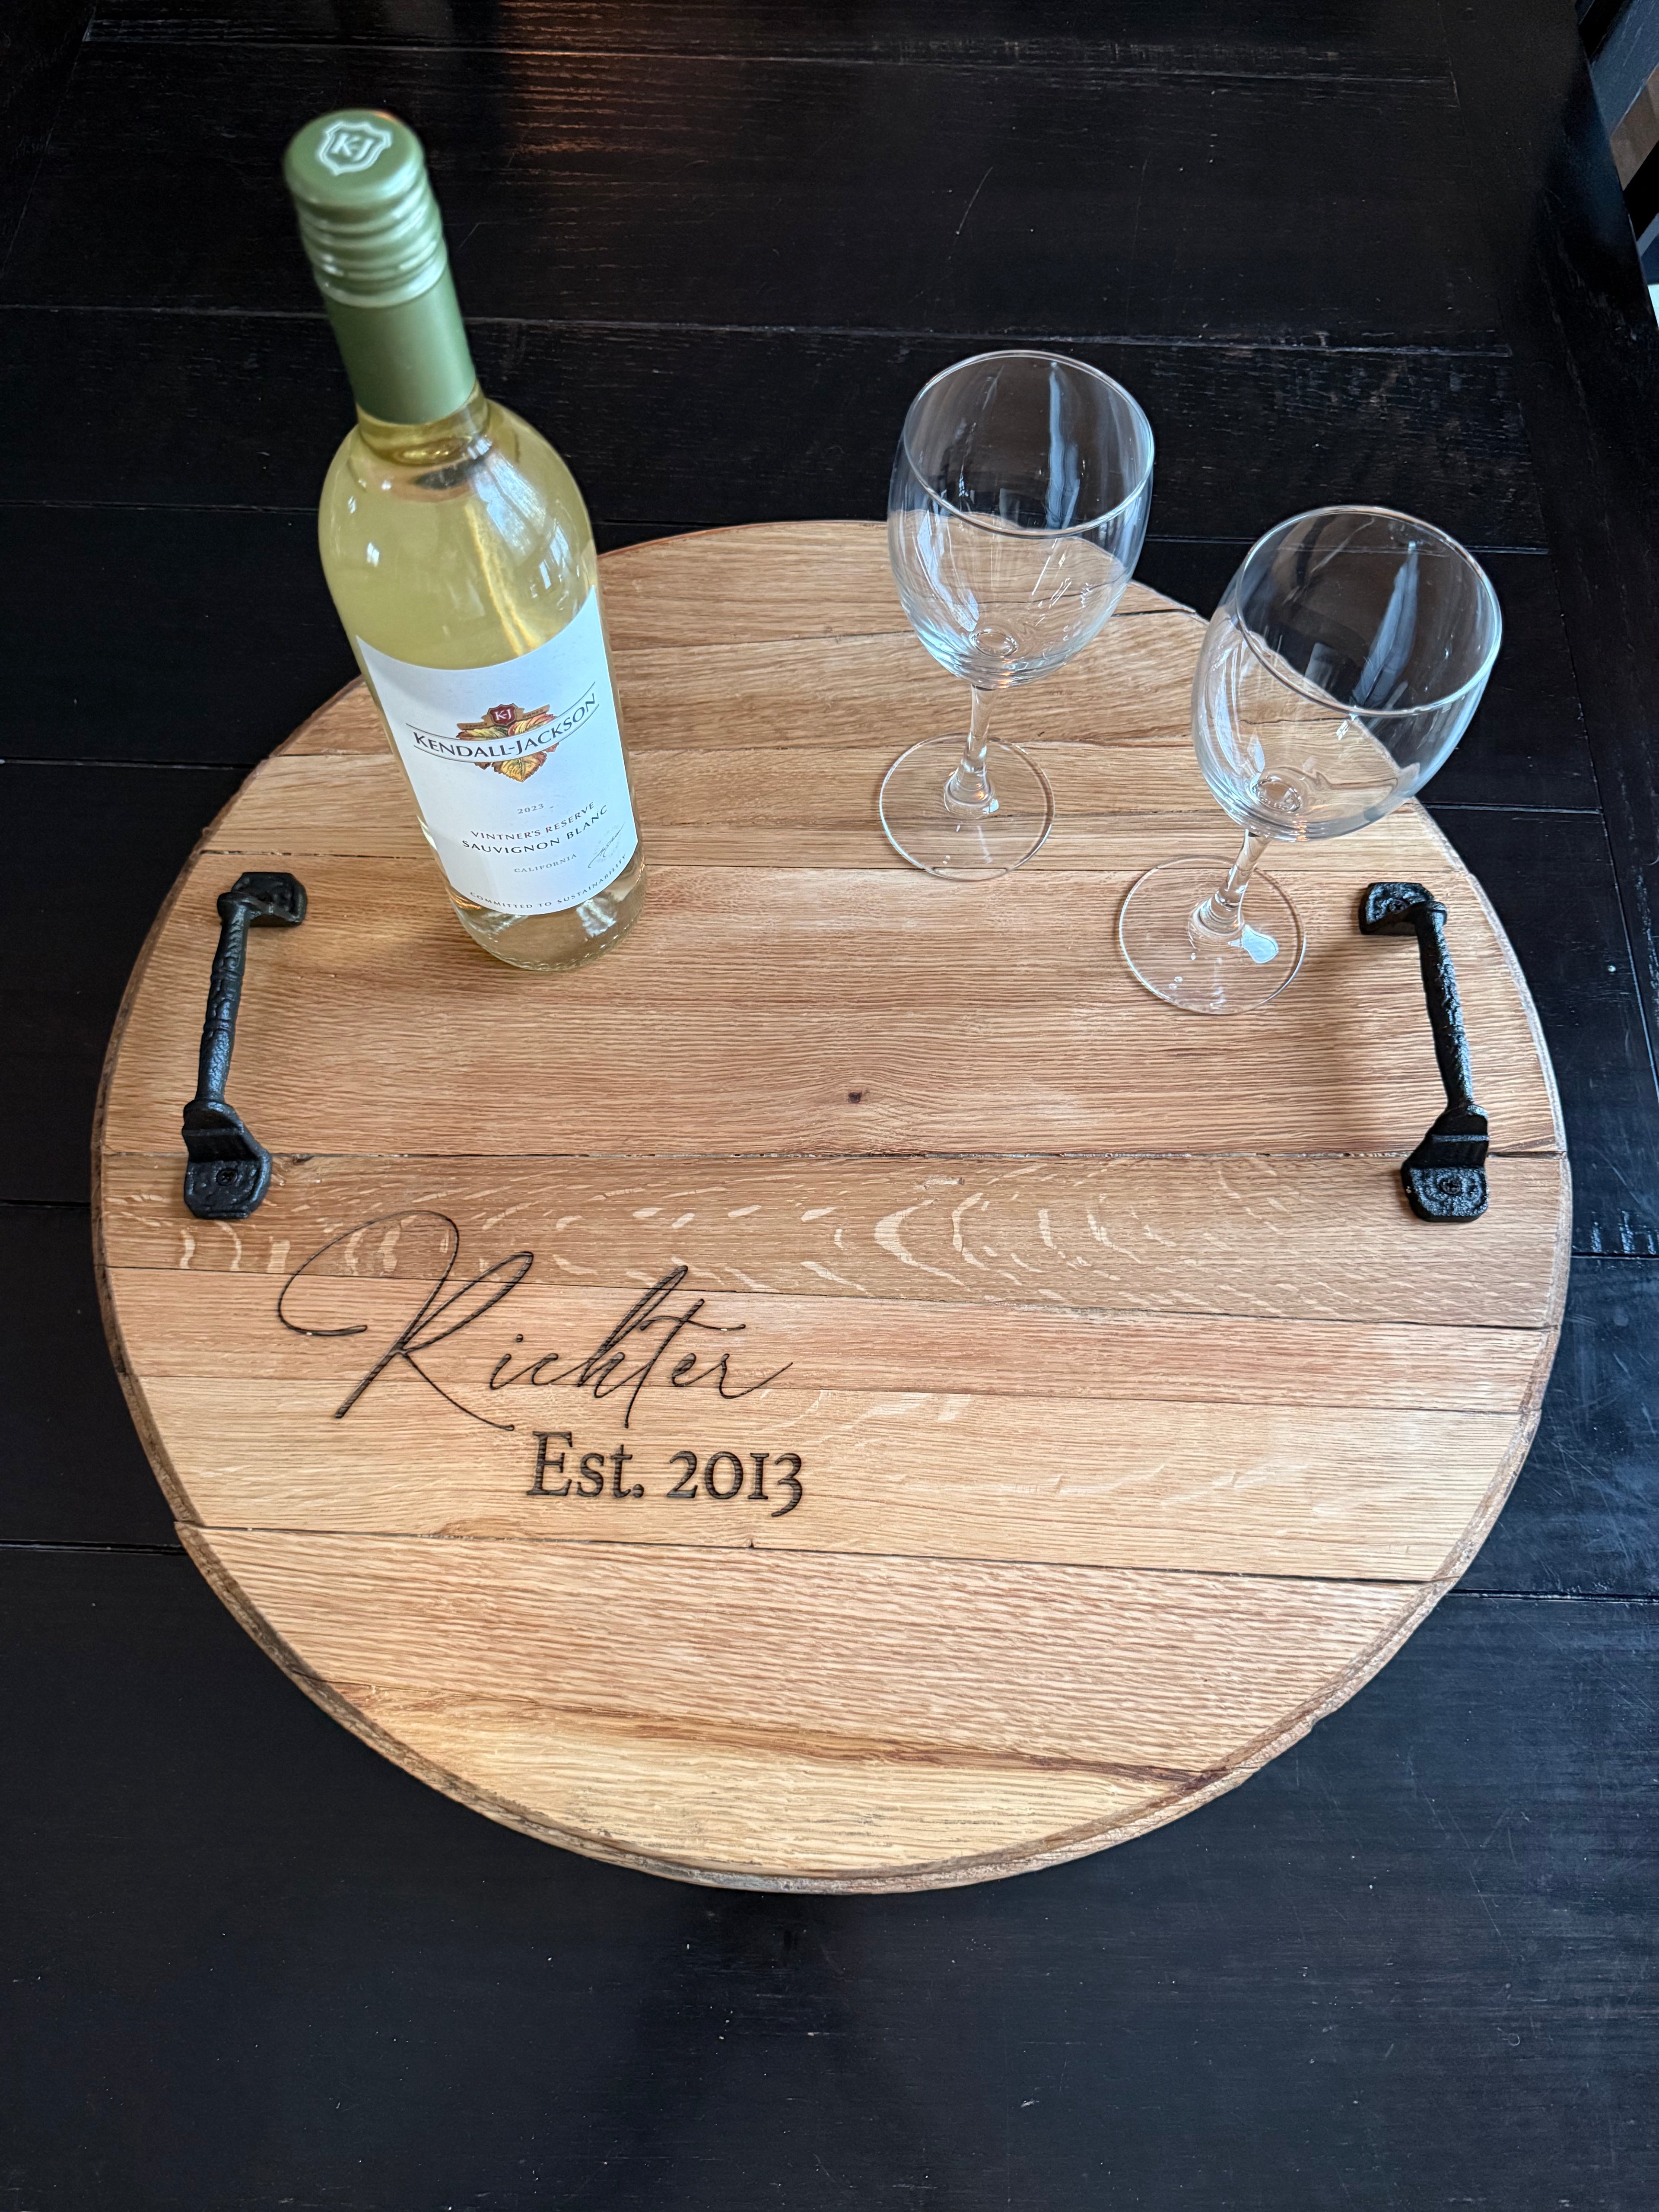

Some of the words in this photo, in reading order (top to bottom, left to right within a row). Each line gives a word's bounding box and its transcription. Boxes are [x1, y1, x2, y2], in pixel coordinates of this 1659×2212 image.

[413, 693, 596, 757] KENDALL-JACKSON
[494, 709, 512, 721] K-J
[462, 837, 560, 854] SAUVIGNON
[566, 805, 607, 840] BLANC
[471, 830, 541, 840] VINTNER'S
[545, 802, 595, 833] RESERVE
[517, 804, 544, 814] 2023
[470, 892, 533, 909] COMMITTED
[557, 854, 626, 904] SUSTAINABILITY
[514, 854, 577, 873] CALIFORNIA
[277, 1209, 794, 1432] Richter
[526, 1430, 645, 1500] Est.
[667, 1449, 804, 1518] 2013
